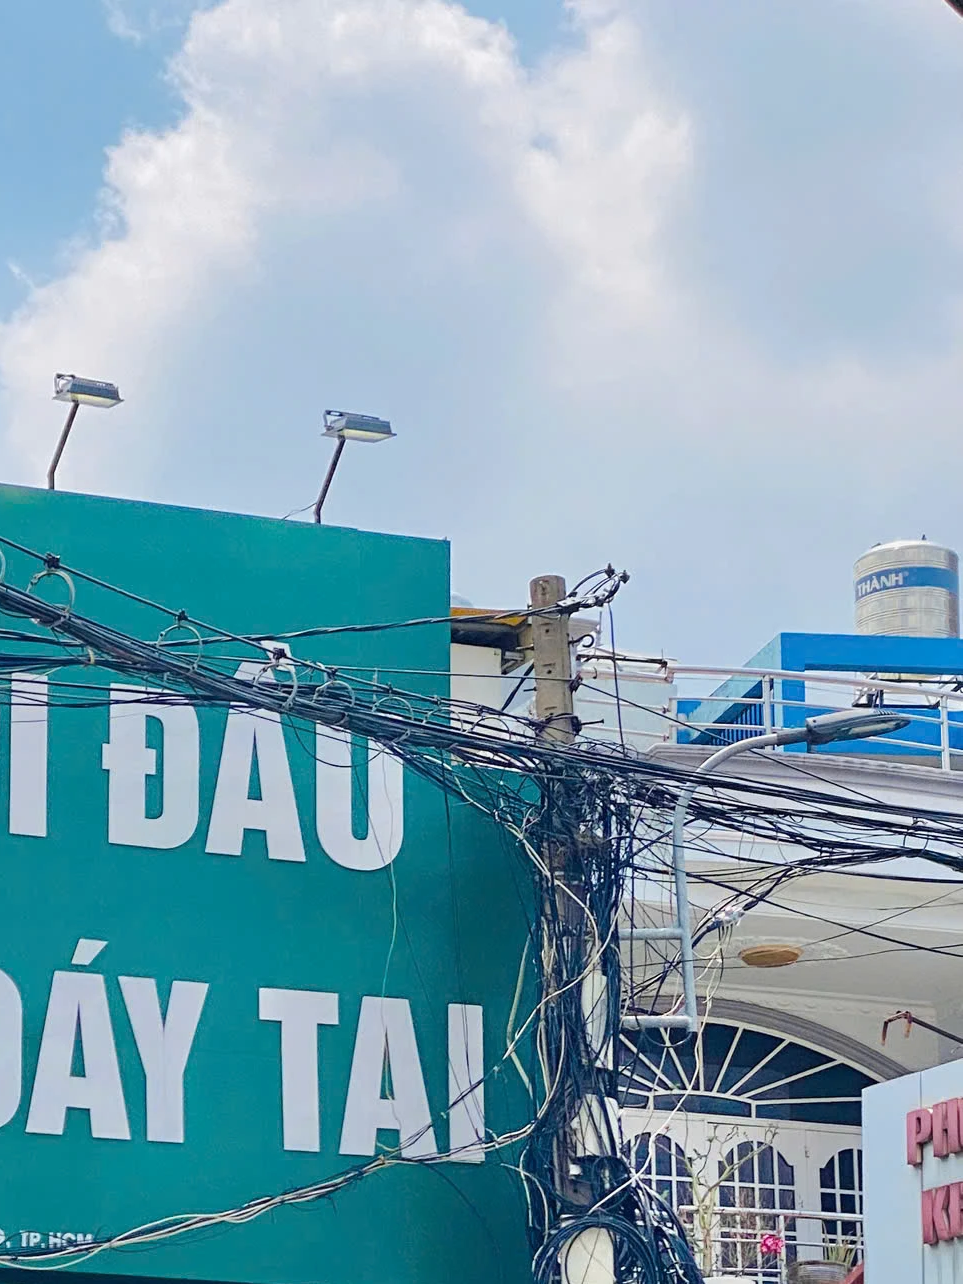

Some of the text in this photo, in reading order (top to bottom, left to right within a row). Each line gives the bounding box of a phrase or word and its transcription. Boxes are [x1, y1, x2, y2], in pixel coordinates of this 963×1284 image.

[102, 640, 404, 871] ĐẦU
[258, 987, 485, 1164] TAI
[906, 1098, 963, 1166] PH
